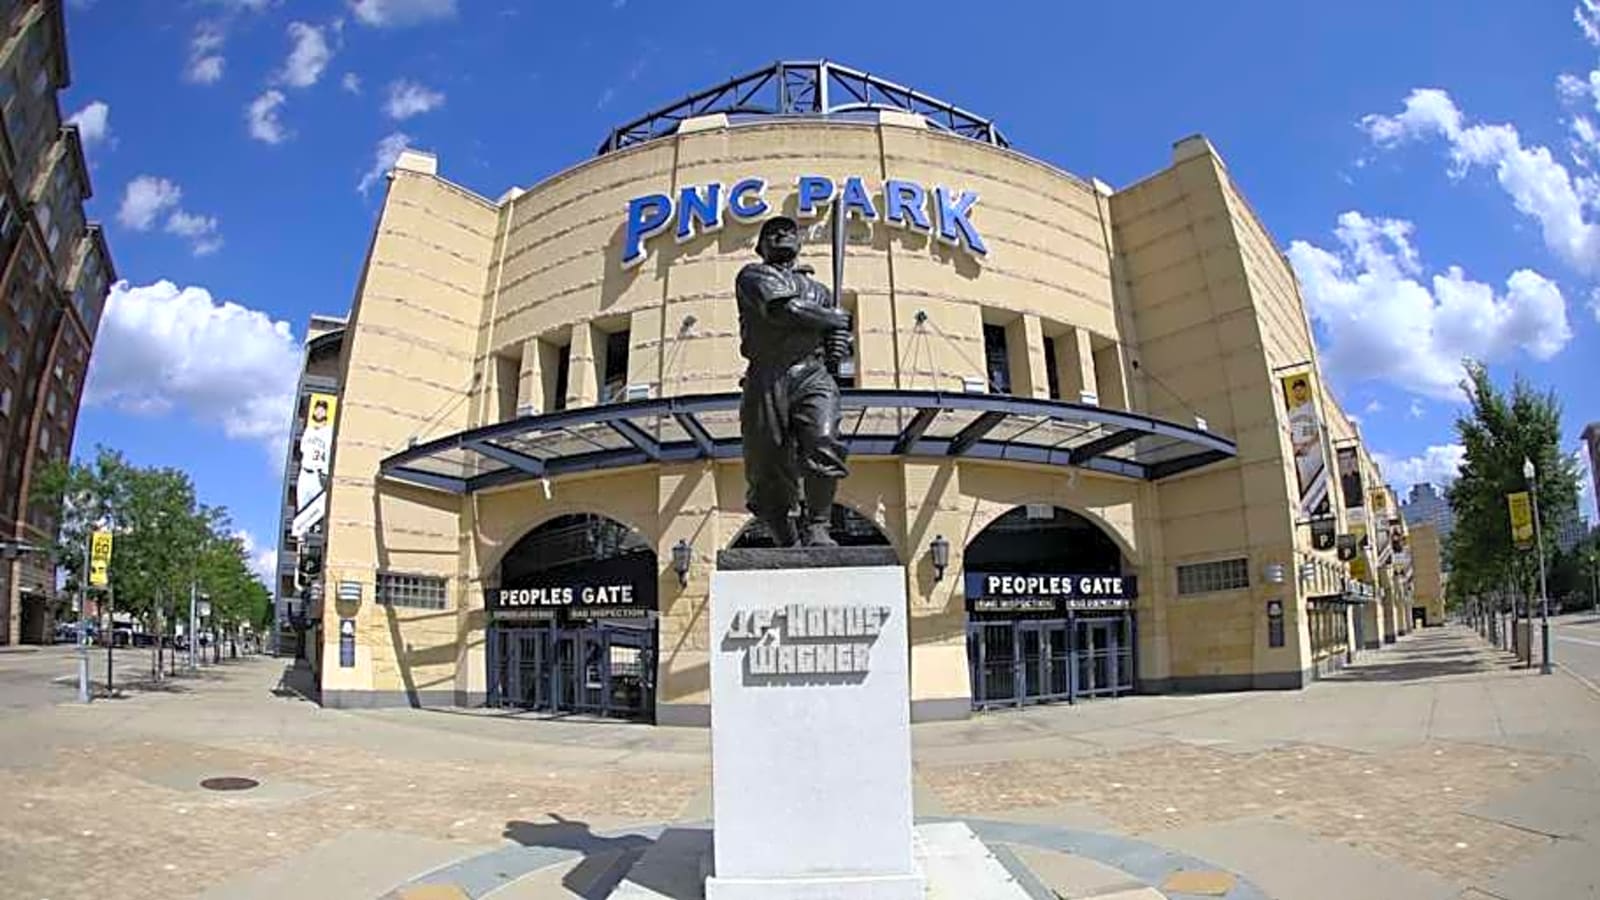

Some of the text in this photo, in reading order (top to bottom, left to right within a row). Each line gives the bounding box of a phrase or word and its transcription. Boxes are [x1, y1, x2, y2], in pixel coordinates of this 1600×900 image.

[620, 175, 991, 269] PNC PARK
[500, 585, 633, 606] PEOPLES GATE
[988, 575, 1123, 594] PEOPLES GATE
[750, 642, 870, 674] WAGNER
